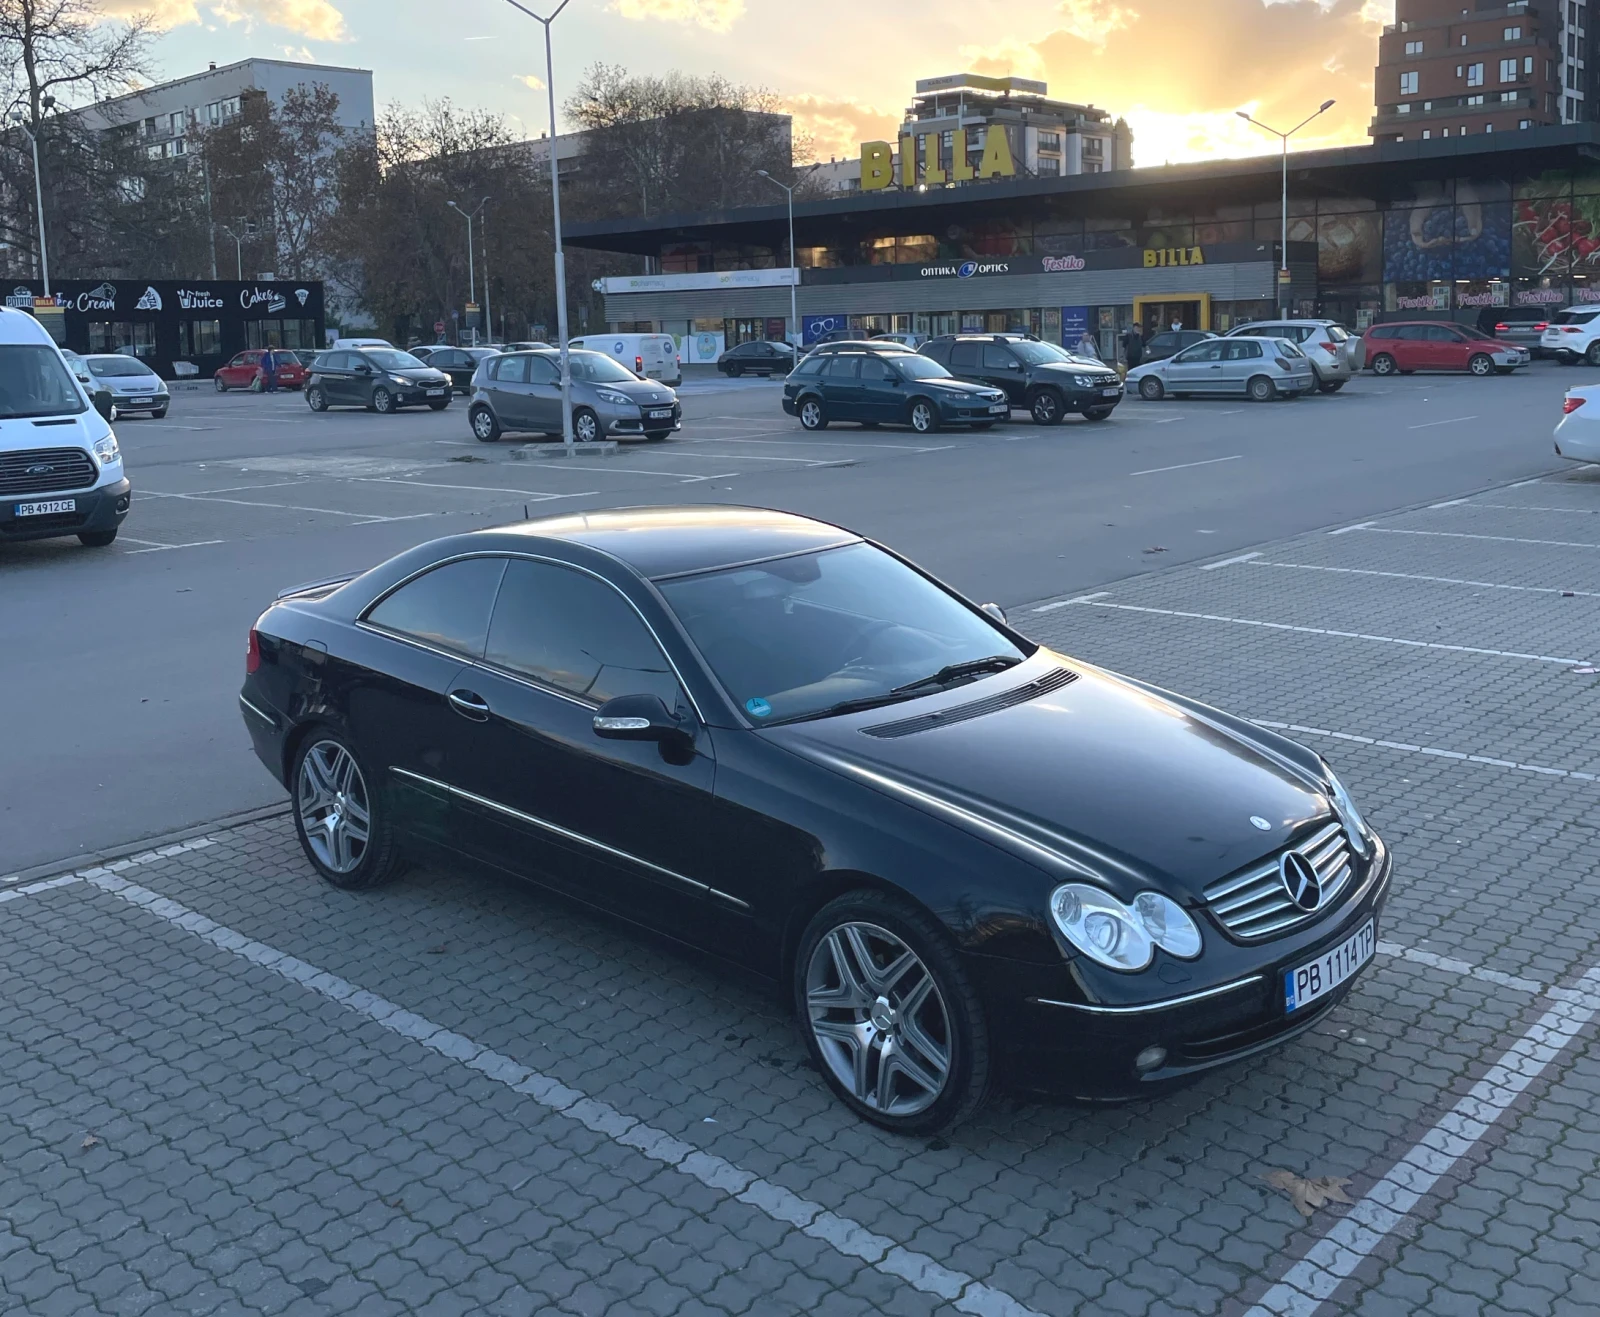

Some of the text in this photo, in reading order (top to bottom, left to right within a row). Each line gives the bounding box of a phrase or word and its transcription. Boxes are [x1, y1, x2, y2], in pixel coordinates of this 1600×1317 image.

[861, 125, 1015, 191] BILLA
[1042, 255, 1085, 272] Festiko
[1143, 246, 1204, 267] BILLA
[921, 263, 1008, 277] ОПТИКА OPTICS
[77, 293, 115, 312] Cream
[191, 298, 223, 308] Juice
[240, 287, 273, 309] Cakes
[1397, 296, 1438, 309] Festiko
[1457, 292, 1500, 306] Festiko
[1517, 290, 1564, 303] Festiko
[21, 501, 74, 515] PB 4912 CE
[1297, 923, 1373, 1002] PB 1114 TP
